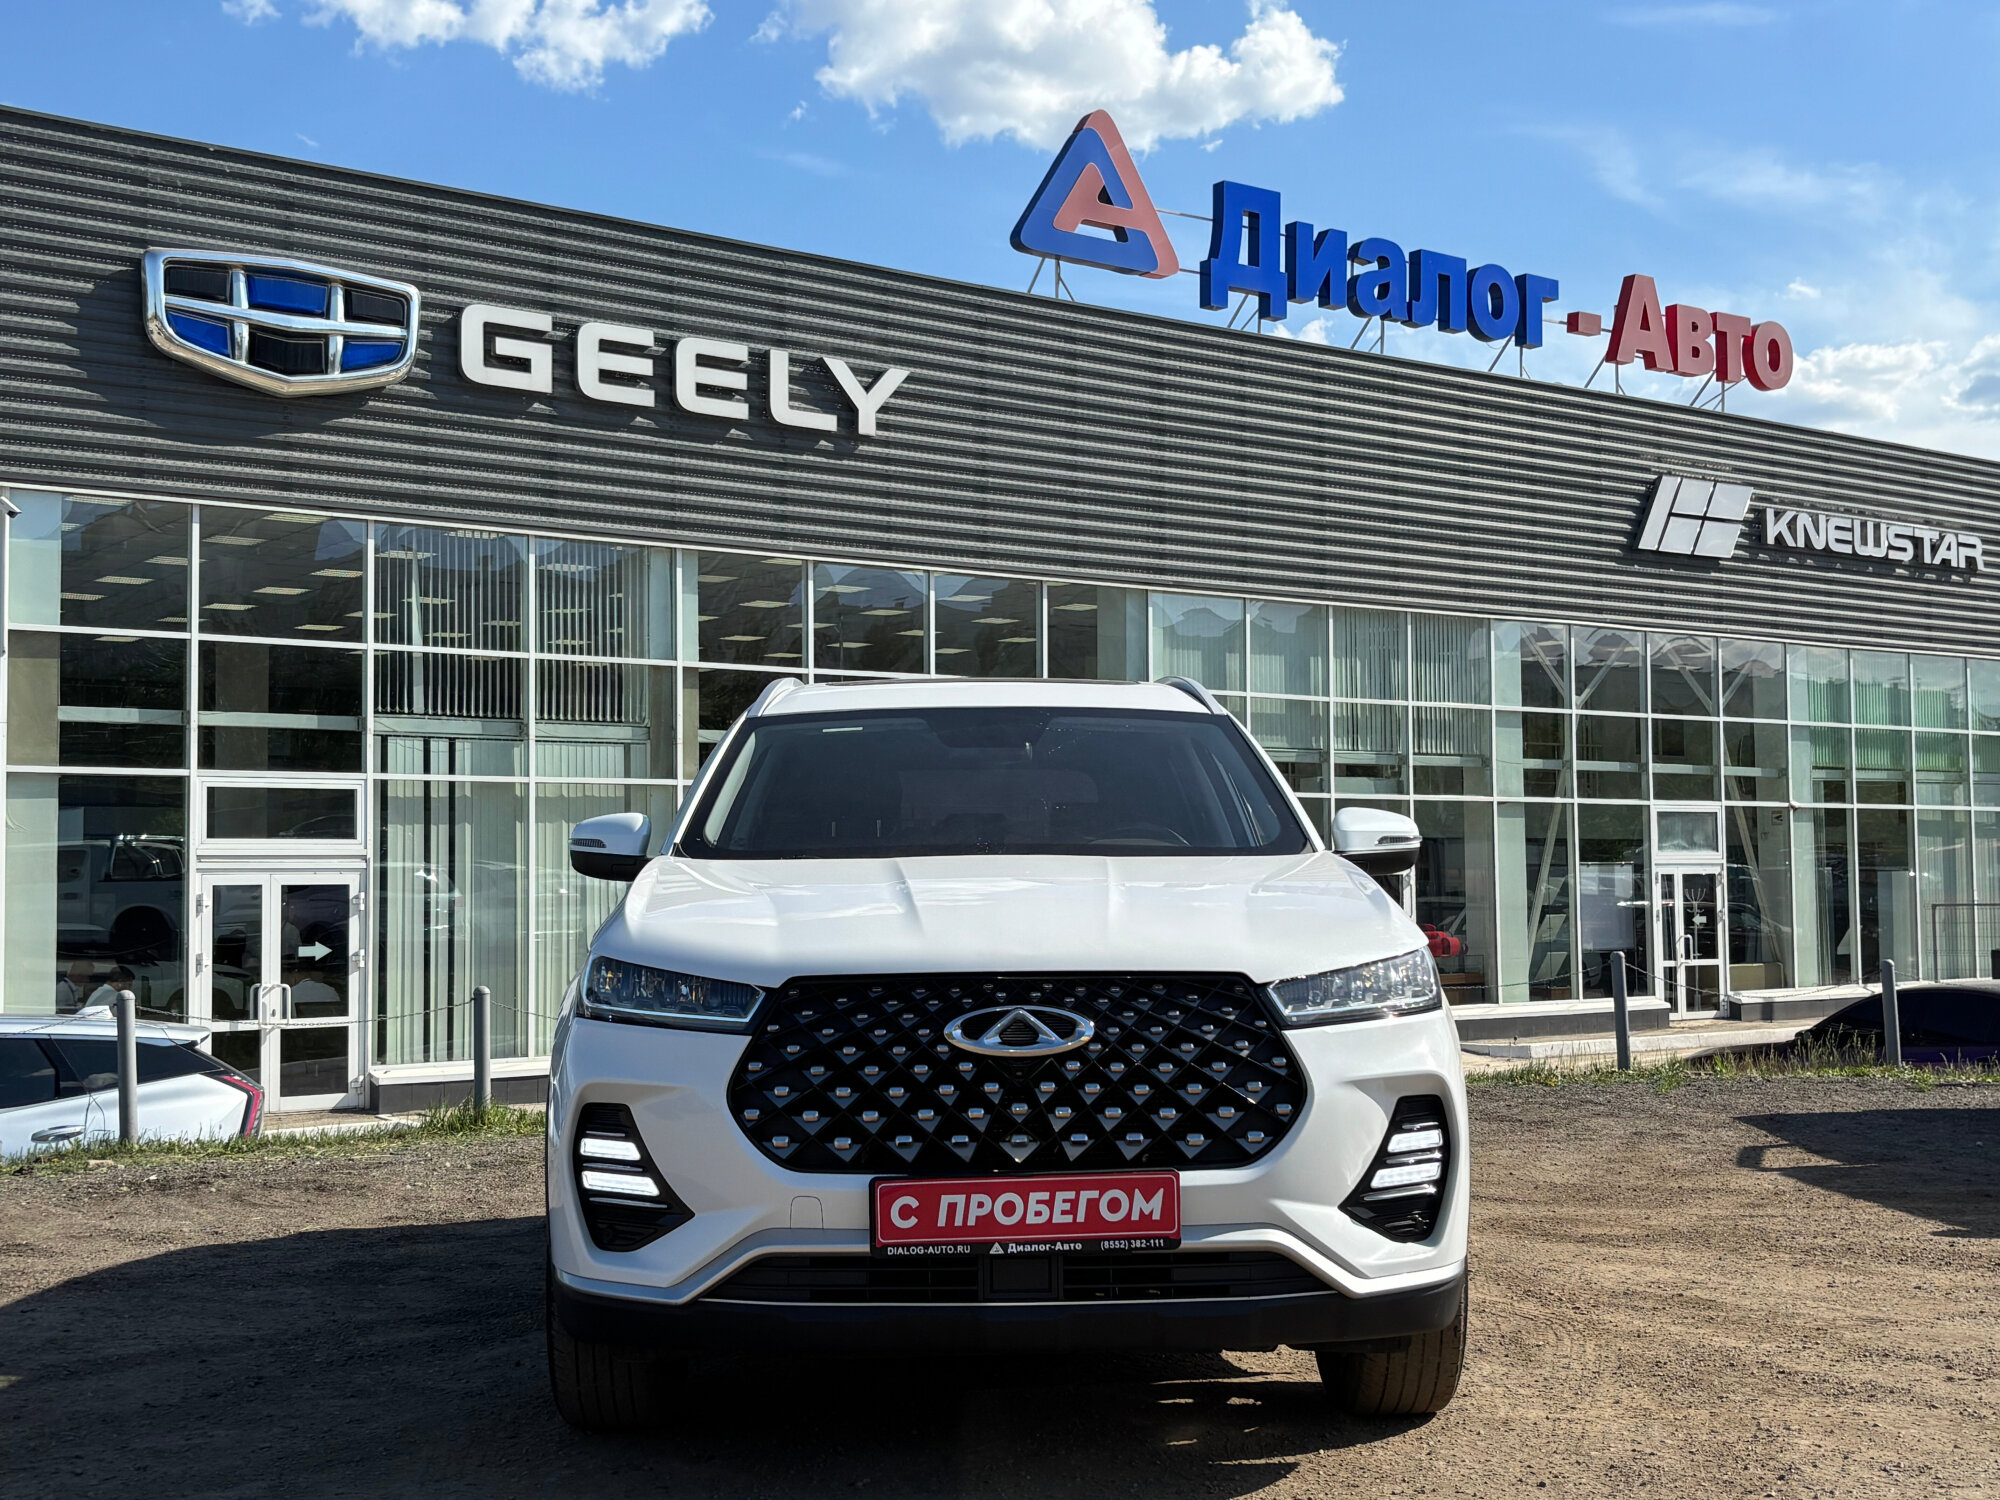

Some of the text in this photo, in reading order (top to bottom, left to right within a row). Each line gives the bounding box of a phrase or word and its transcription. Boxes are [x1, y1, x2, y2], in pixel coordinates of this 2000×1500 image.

[458, 304, 910, 437] GEELY
[1764, 508, 1984, 571] KNEWSTAR
[890, 1187, 1164, 1228] С ПРОБЕГОМ
[887, 1245, 971, 1255] DIALOG-AUTO.RU
[1007, 1241, 1083, 1254] Диалог-Авто
[1100, 1239, 1164, 1251] (8552) 382-111
